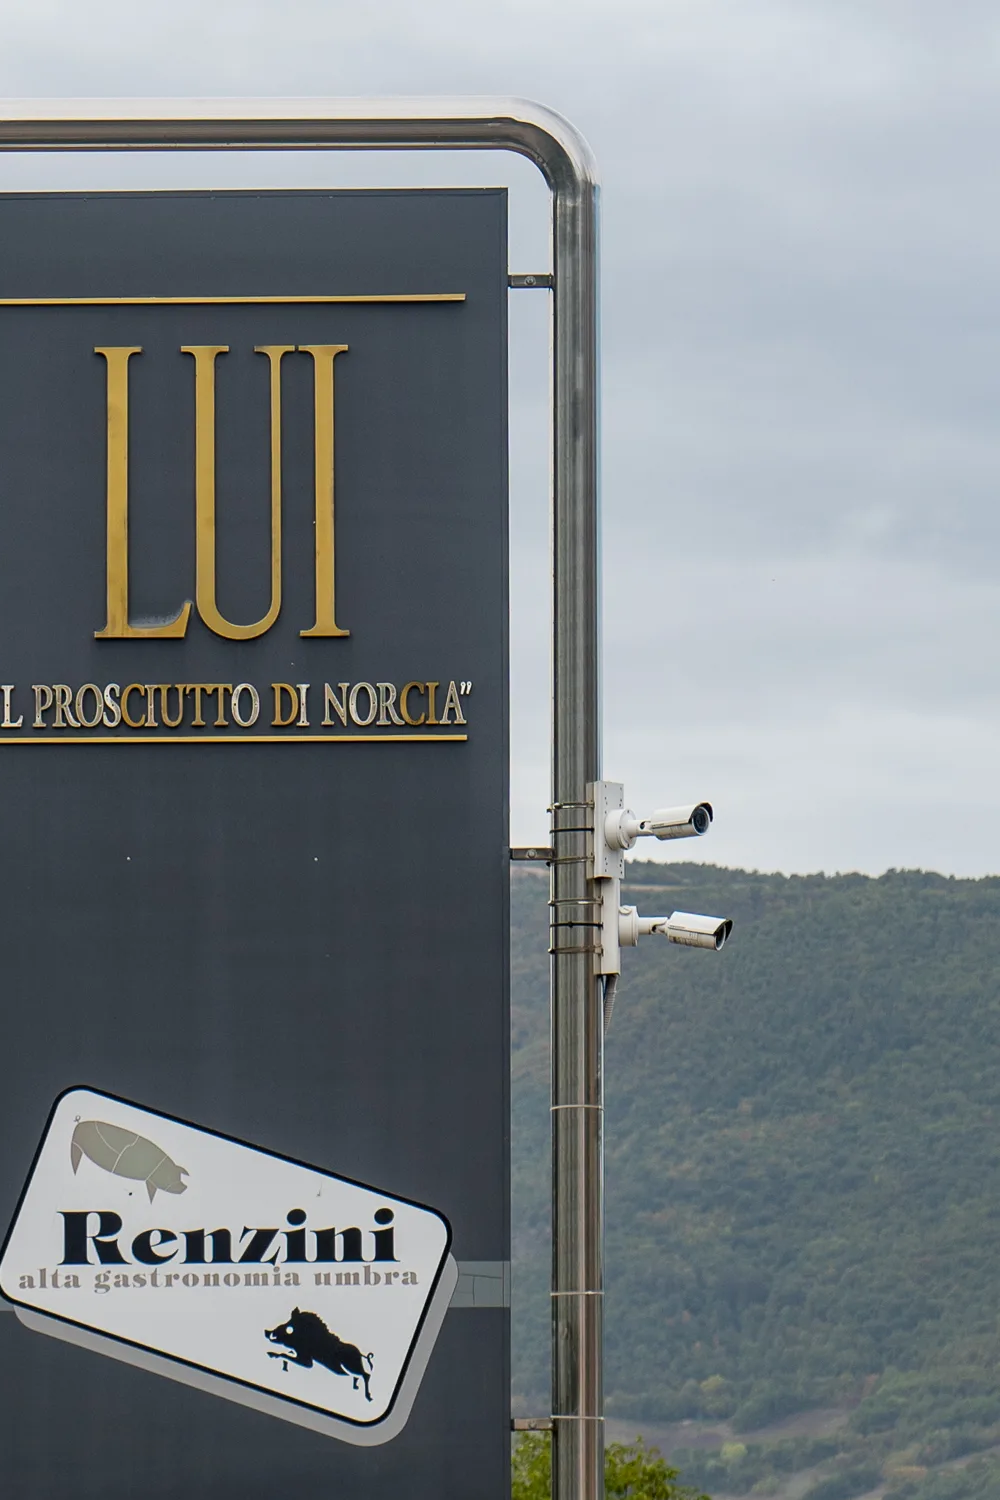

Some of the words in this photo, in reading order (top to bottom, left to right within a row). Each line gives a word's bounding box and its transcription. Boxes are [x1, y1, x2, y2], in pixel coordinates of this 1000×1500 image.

[94, 345, 350, 640] LUI
[32, 683, 260, 728] PROSCIUTTO
[271, 683, 310, 727] DI
[57, 1207, 401, 1266] Renzini
[18, 1267, 82, 1290] alta
[94, 1267, 301, 1294] gastronomia
[313, 1265, 419, 1288] umbra
